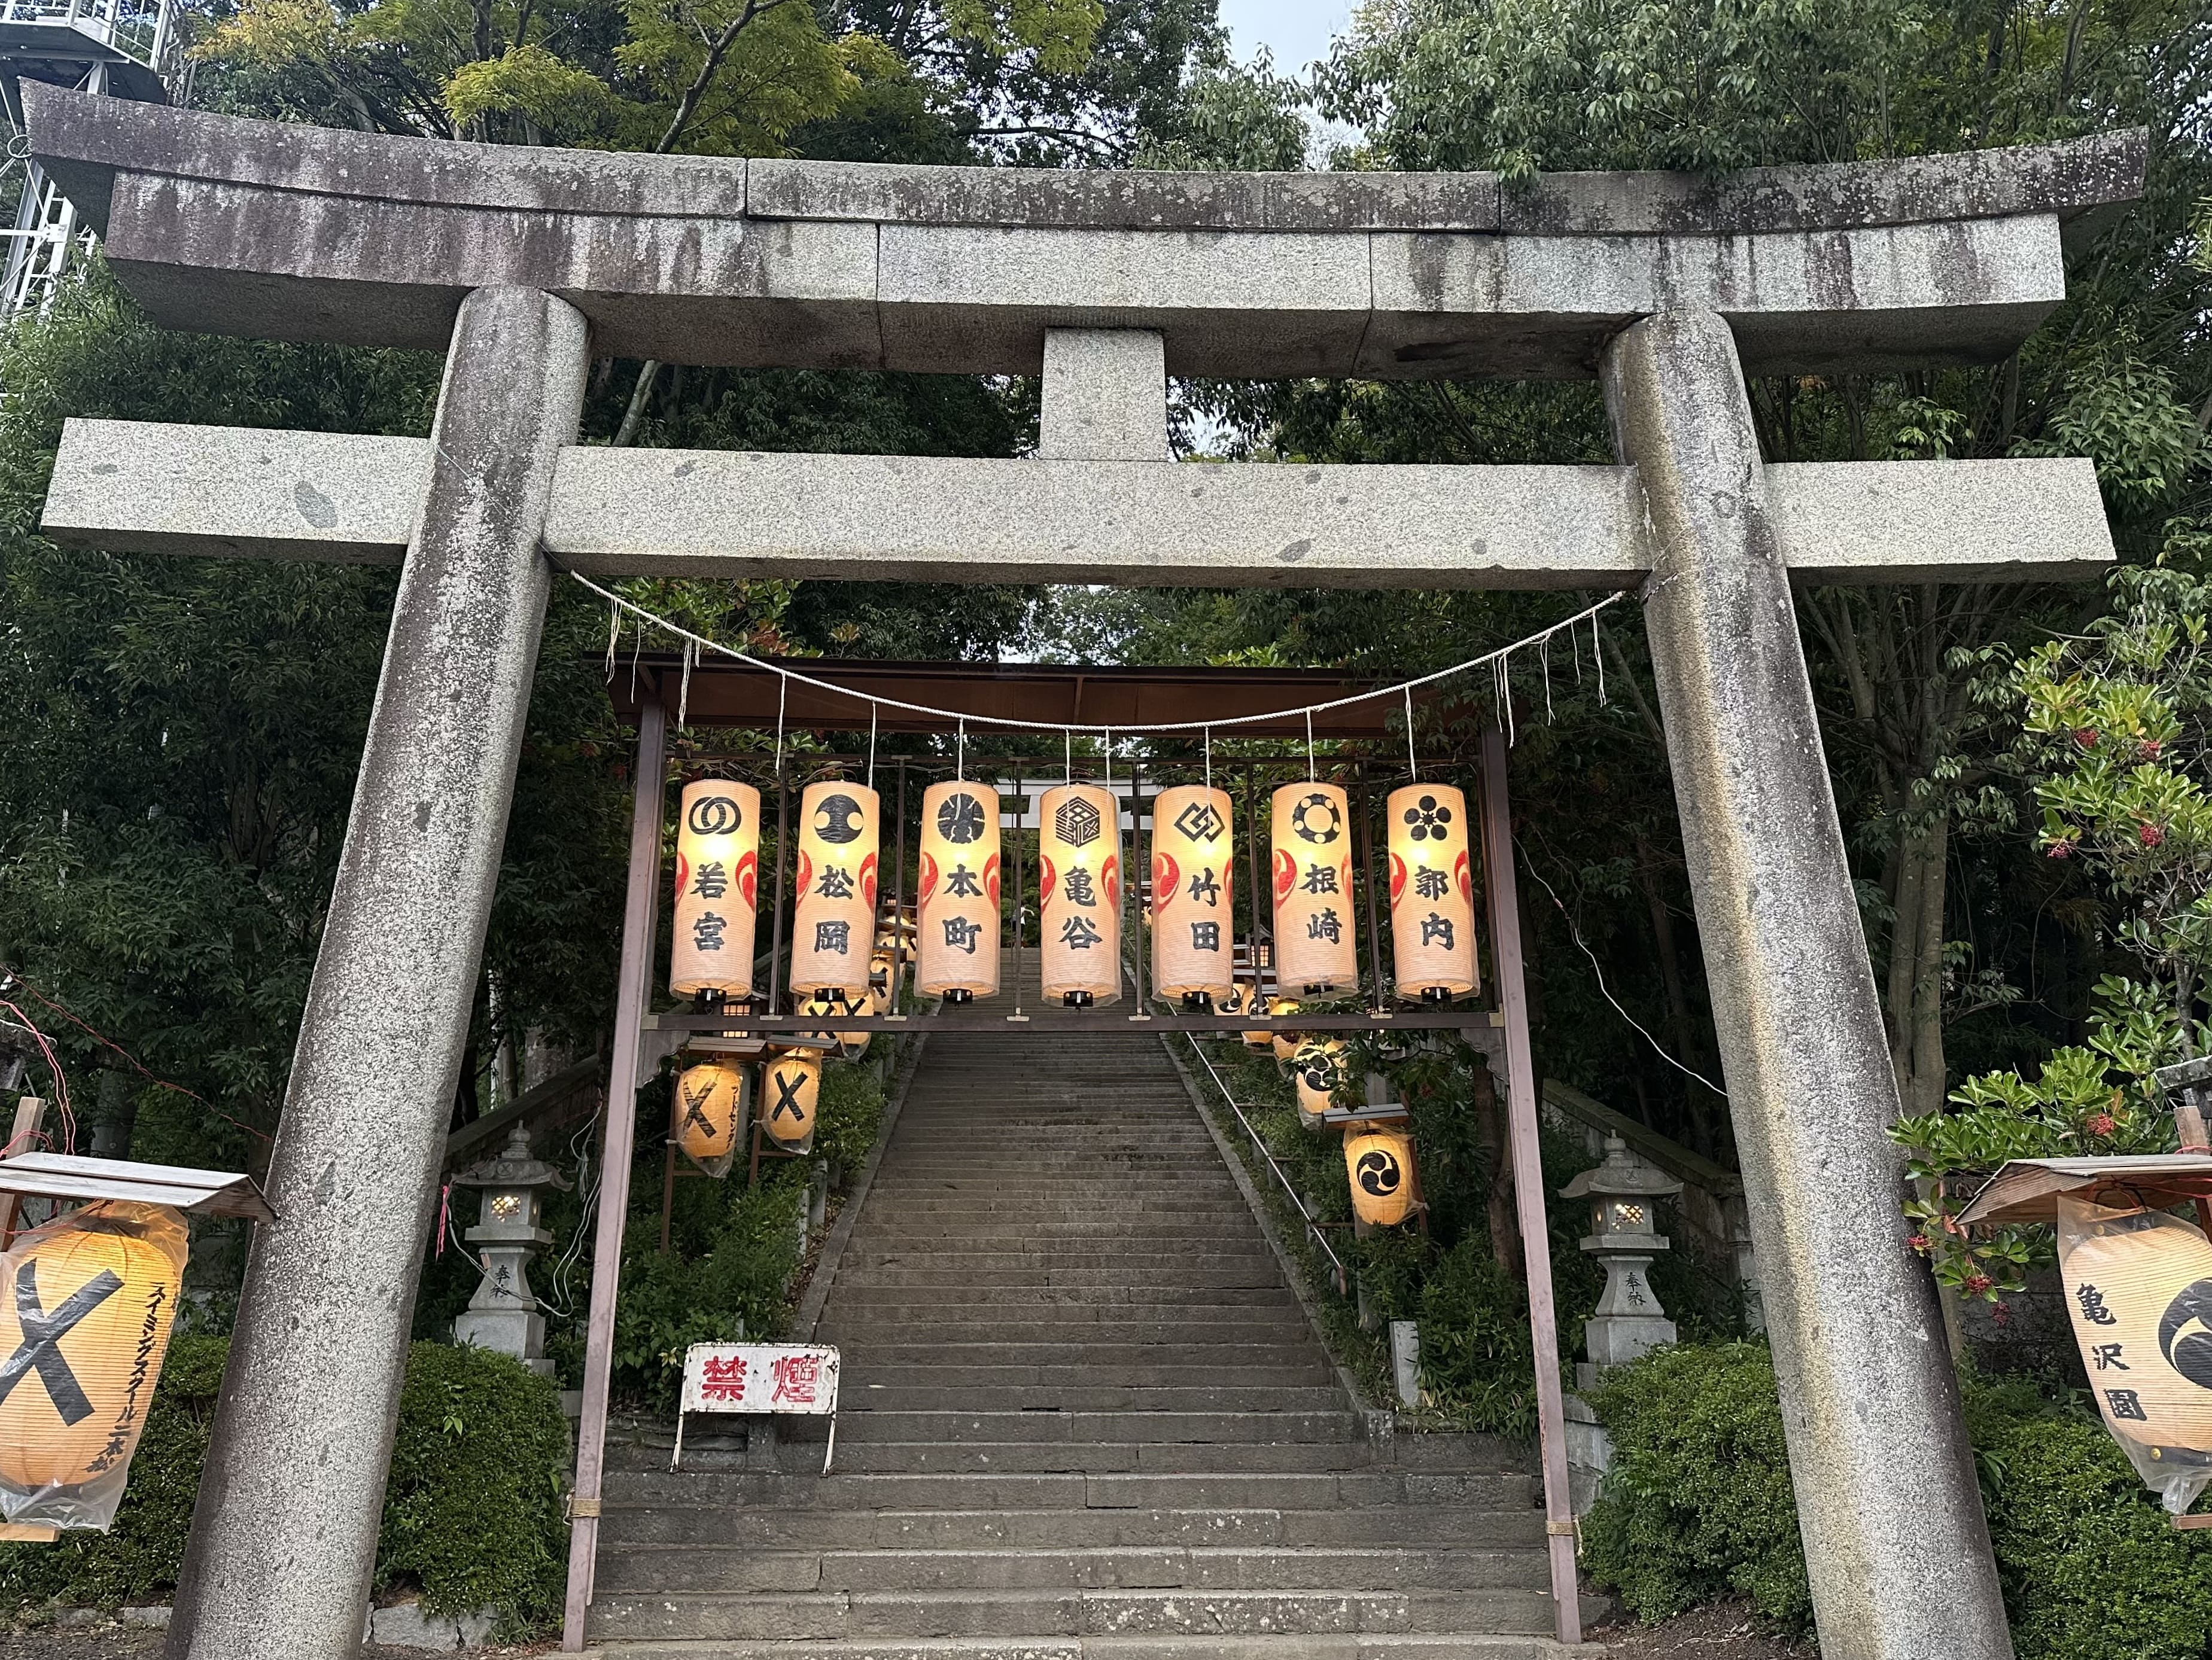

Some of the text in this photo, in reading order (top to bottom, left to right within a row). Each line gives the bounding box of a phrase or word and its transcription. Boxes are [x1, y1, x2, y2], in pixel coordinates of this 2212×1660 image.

[690, 861, 728, 951] 若宮
[814, 864, 854, 955] 松岡
[942, 864, 983, 954] 本町
[1060, 866, 1102, 949] 亀谷
[1188, 867, 1221, 952] 竹田
[1299, 864, 1342, 945] 根崎
[1414, 865, 1455, 951] 郭内
[1626, 1272, 1647, 1305] 奉納
[701, 1355, 818, 1402] 禁煙
[2076, 1282, 2147, 1421] 亀沢園
